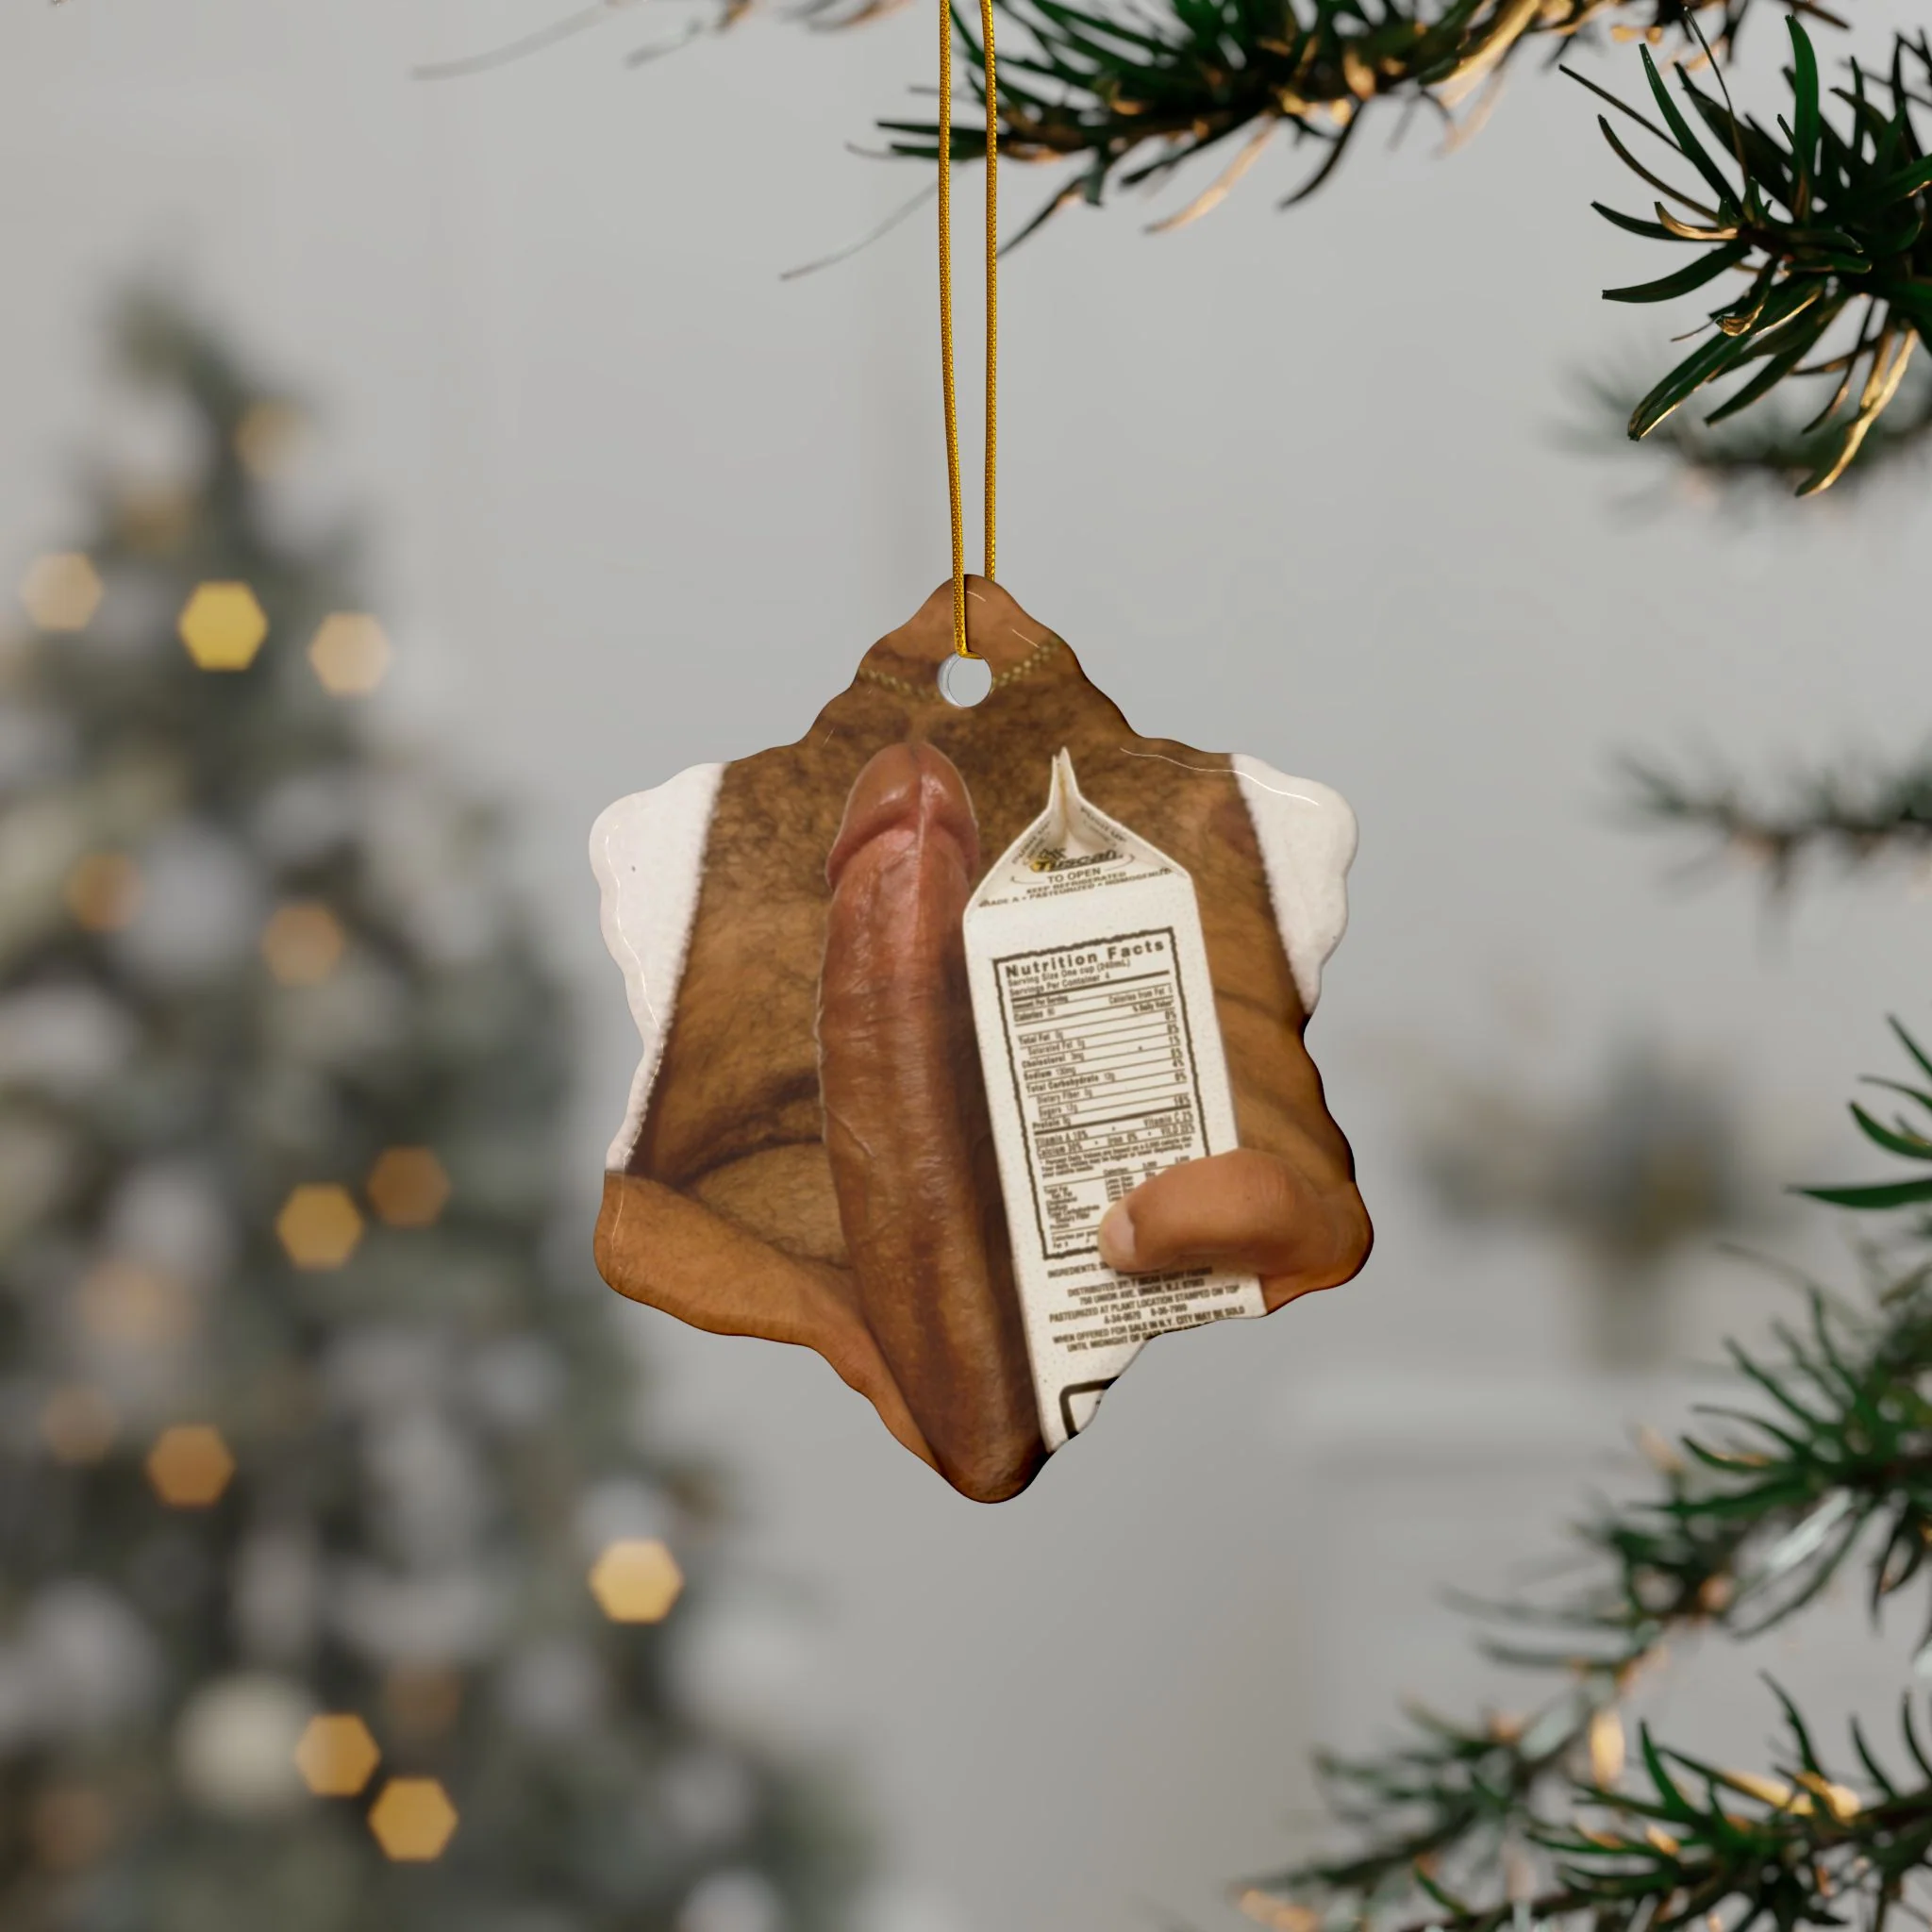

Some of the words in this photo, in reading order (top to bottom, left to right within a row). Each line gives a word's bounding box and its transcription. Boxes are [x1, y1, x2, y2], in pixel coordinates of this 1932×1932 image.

[1047, 874, 1064, 884] TO
[1067, 868, 1101, 880] OPEN
[1026, 885, 1051, 894] KEEP
[1006, 953, 1097, 978] Nutrition
[1108, 940, 1164, 960] Facts
[1061, 968, 1076, 977] One
[1079, 964, 1095, 974] cup
